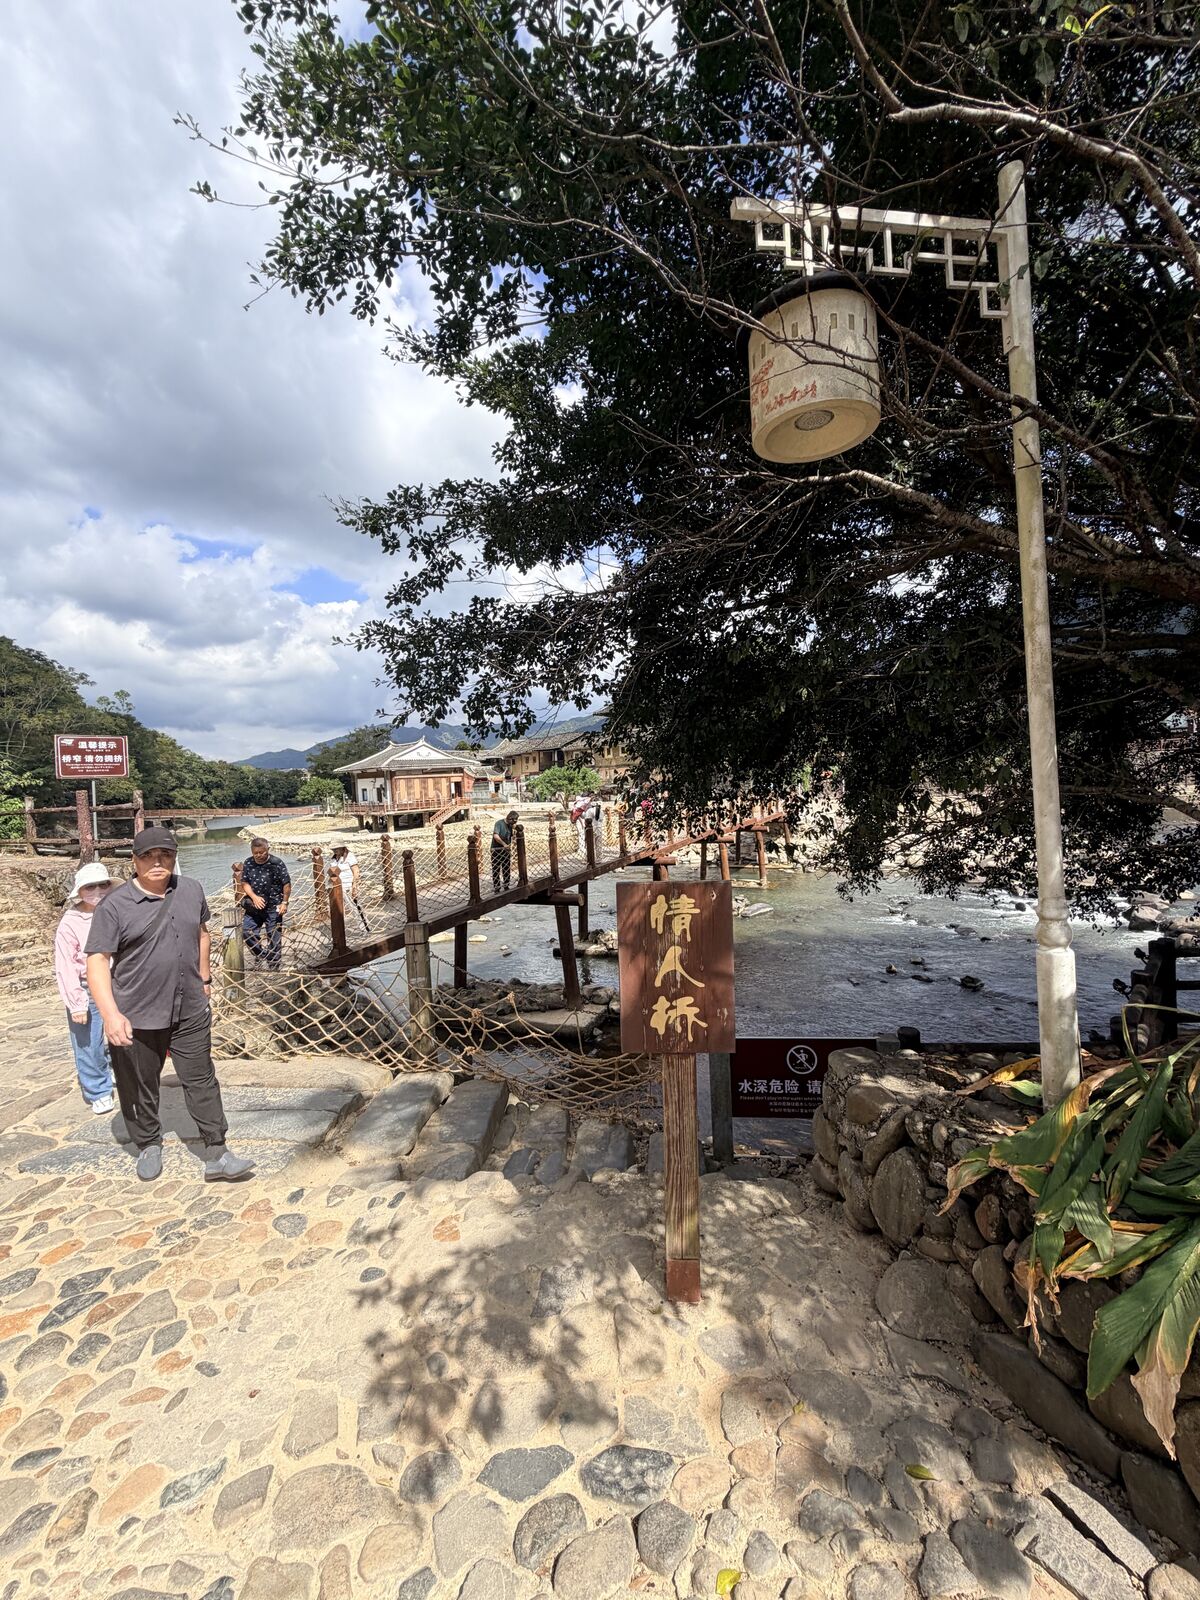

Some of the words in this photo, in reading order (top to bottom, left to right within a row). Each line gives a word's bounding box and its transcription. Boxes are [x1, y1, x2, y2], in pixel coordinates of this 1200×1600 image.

[78, 741, 117, 749] 温馨提示
[650, 894, 708, 1042] 情人桥
[738, 1079, 800, 1094] 水深危险
